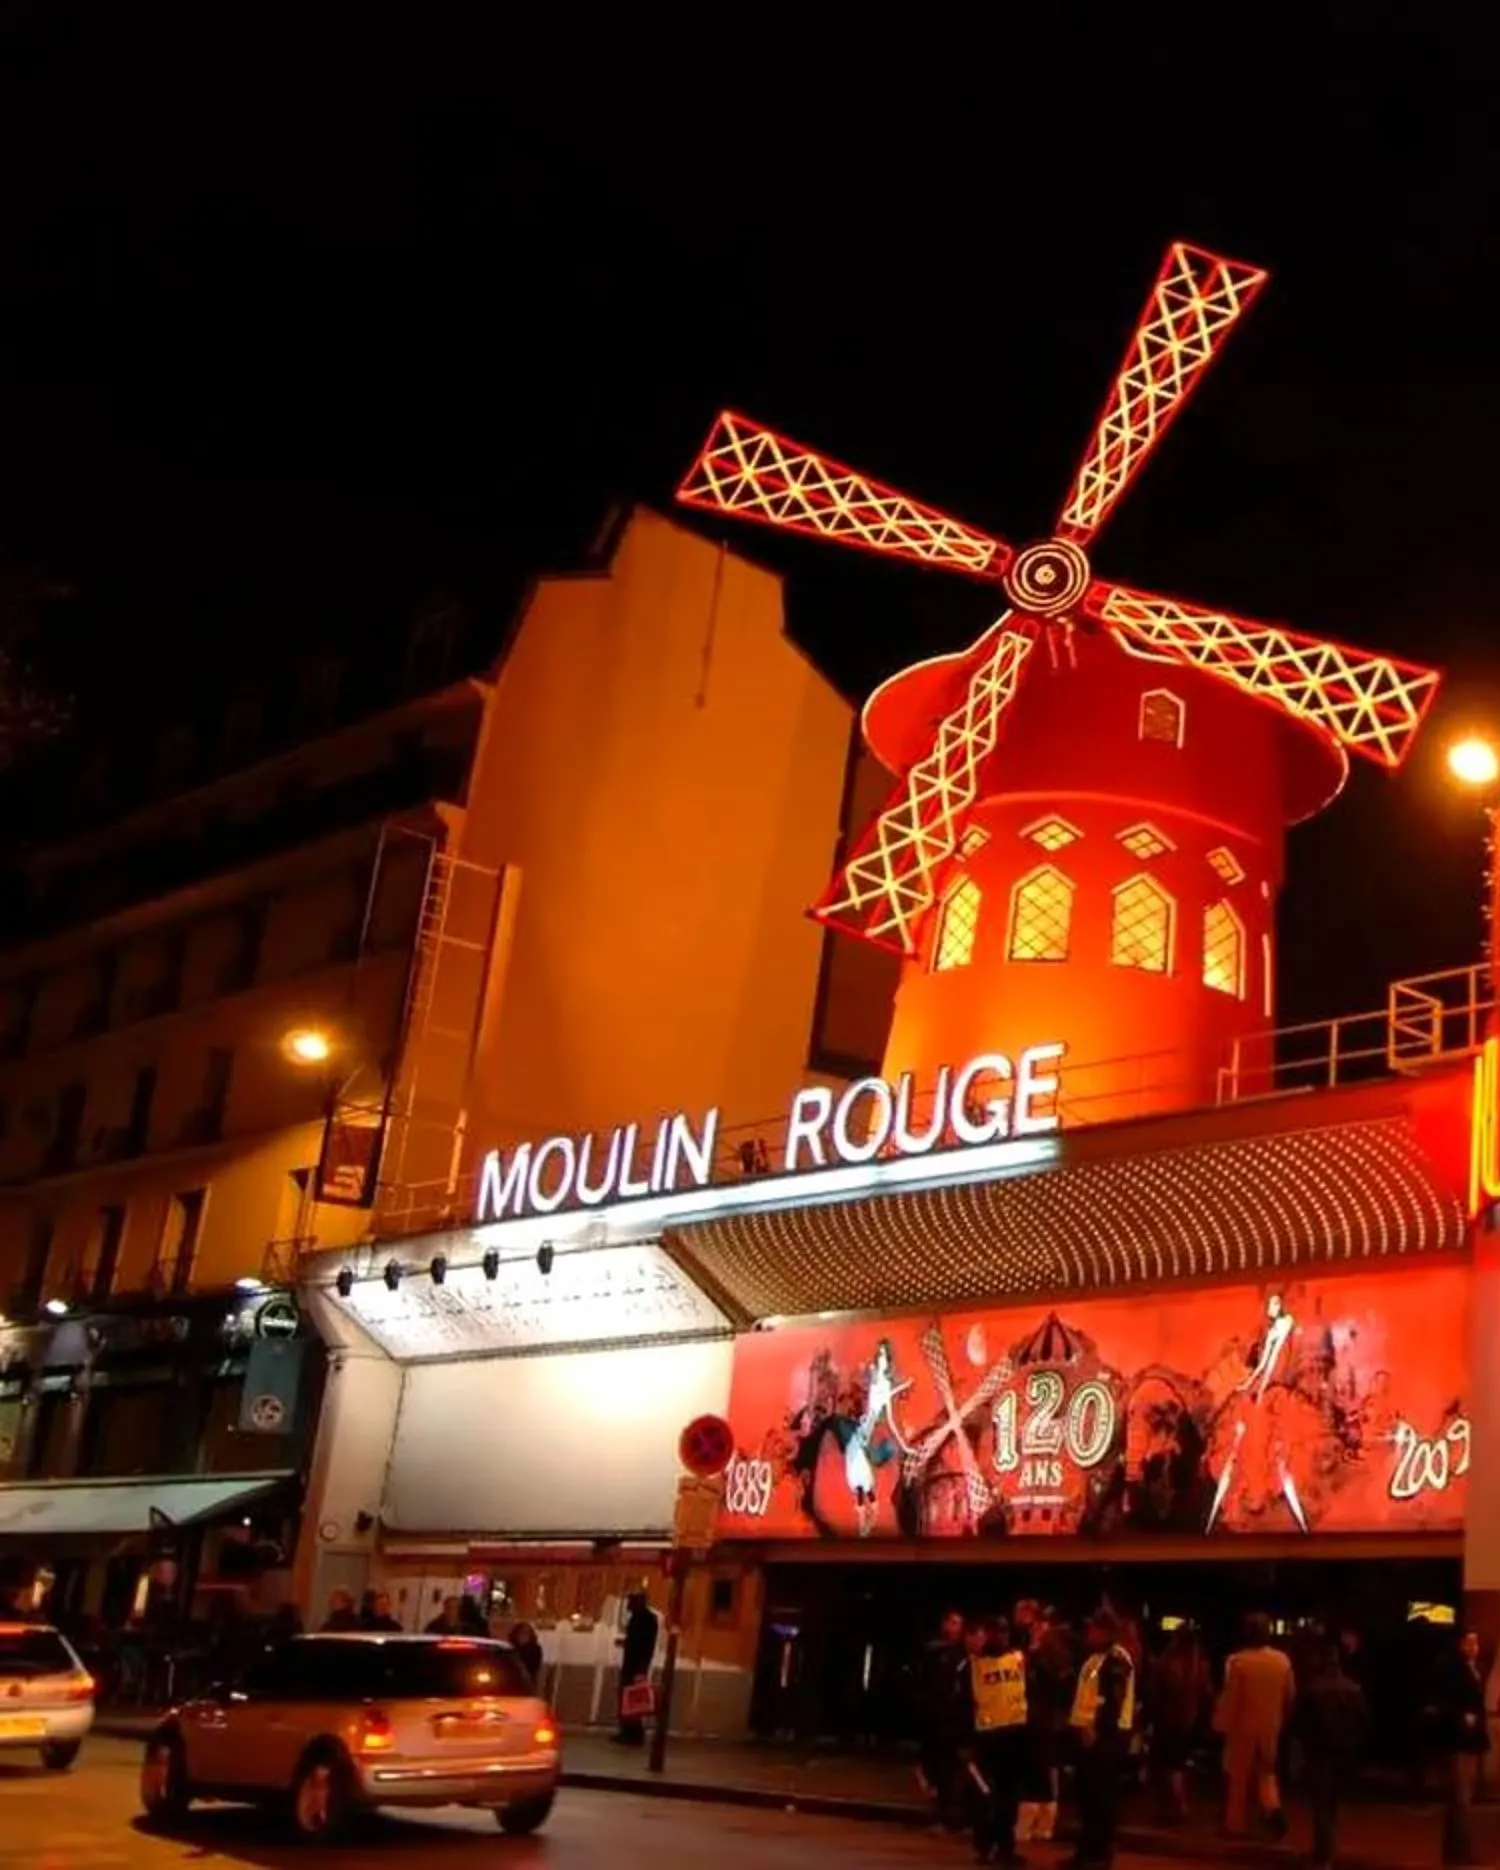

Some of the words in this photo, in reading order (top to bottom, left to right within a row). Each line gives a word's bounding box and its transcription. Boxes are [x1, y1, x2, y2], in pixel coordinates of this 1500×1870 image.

[476, 1106, 718, 1221] MOULIN
[784, 1041, 1068, 1171] ROUGE
[991, 1371, 1116, 1473] 120
[1389, 1418, 1470, 1498] 2009
[724, 1449, 772, 1516] 1889
[1018, 1459, 1064, 1488] ANS
